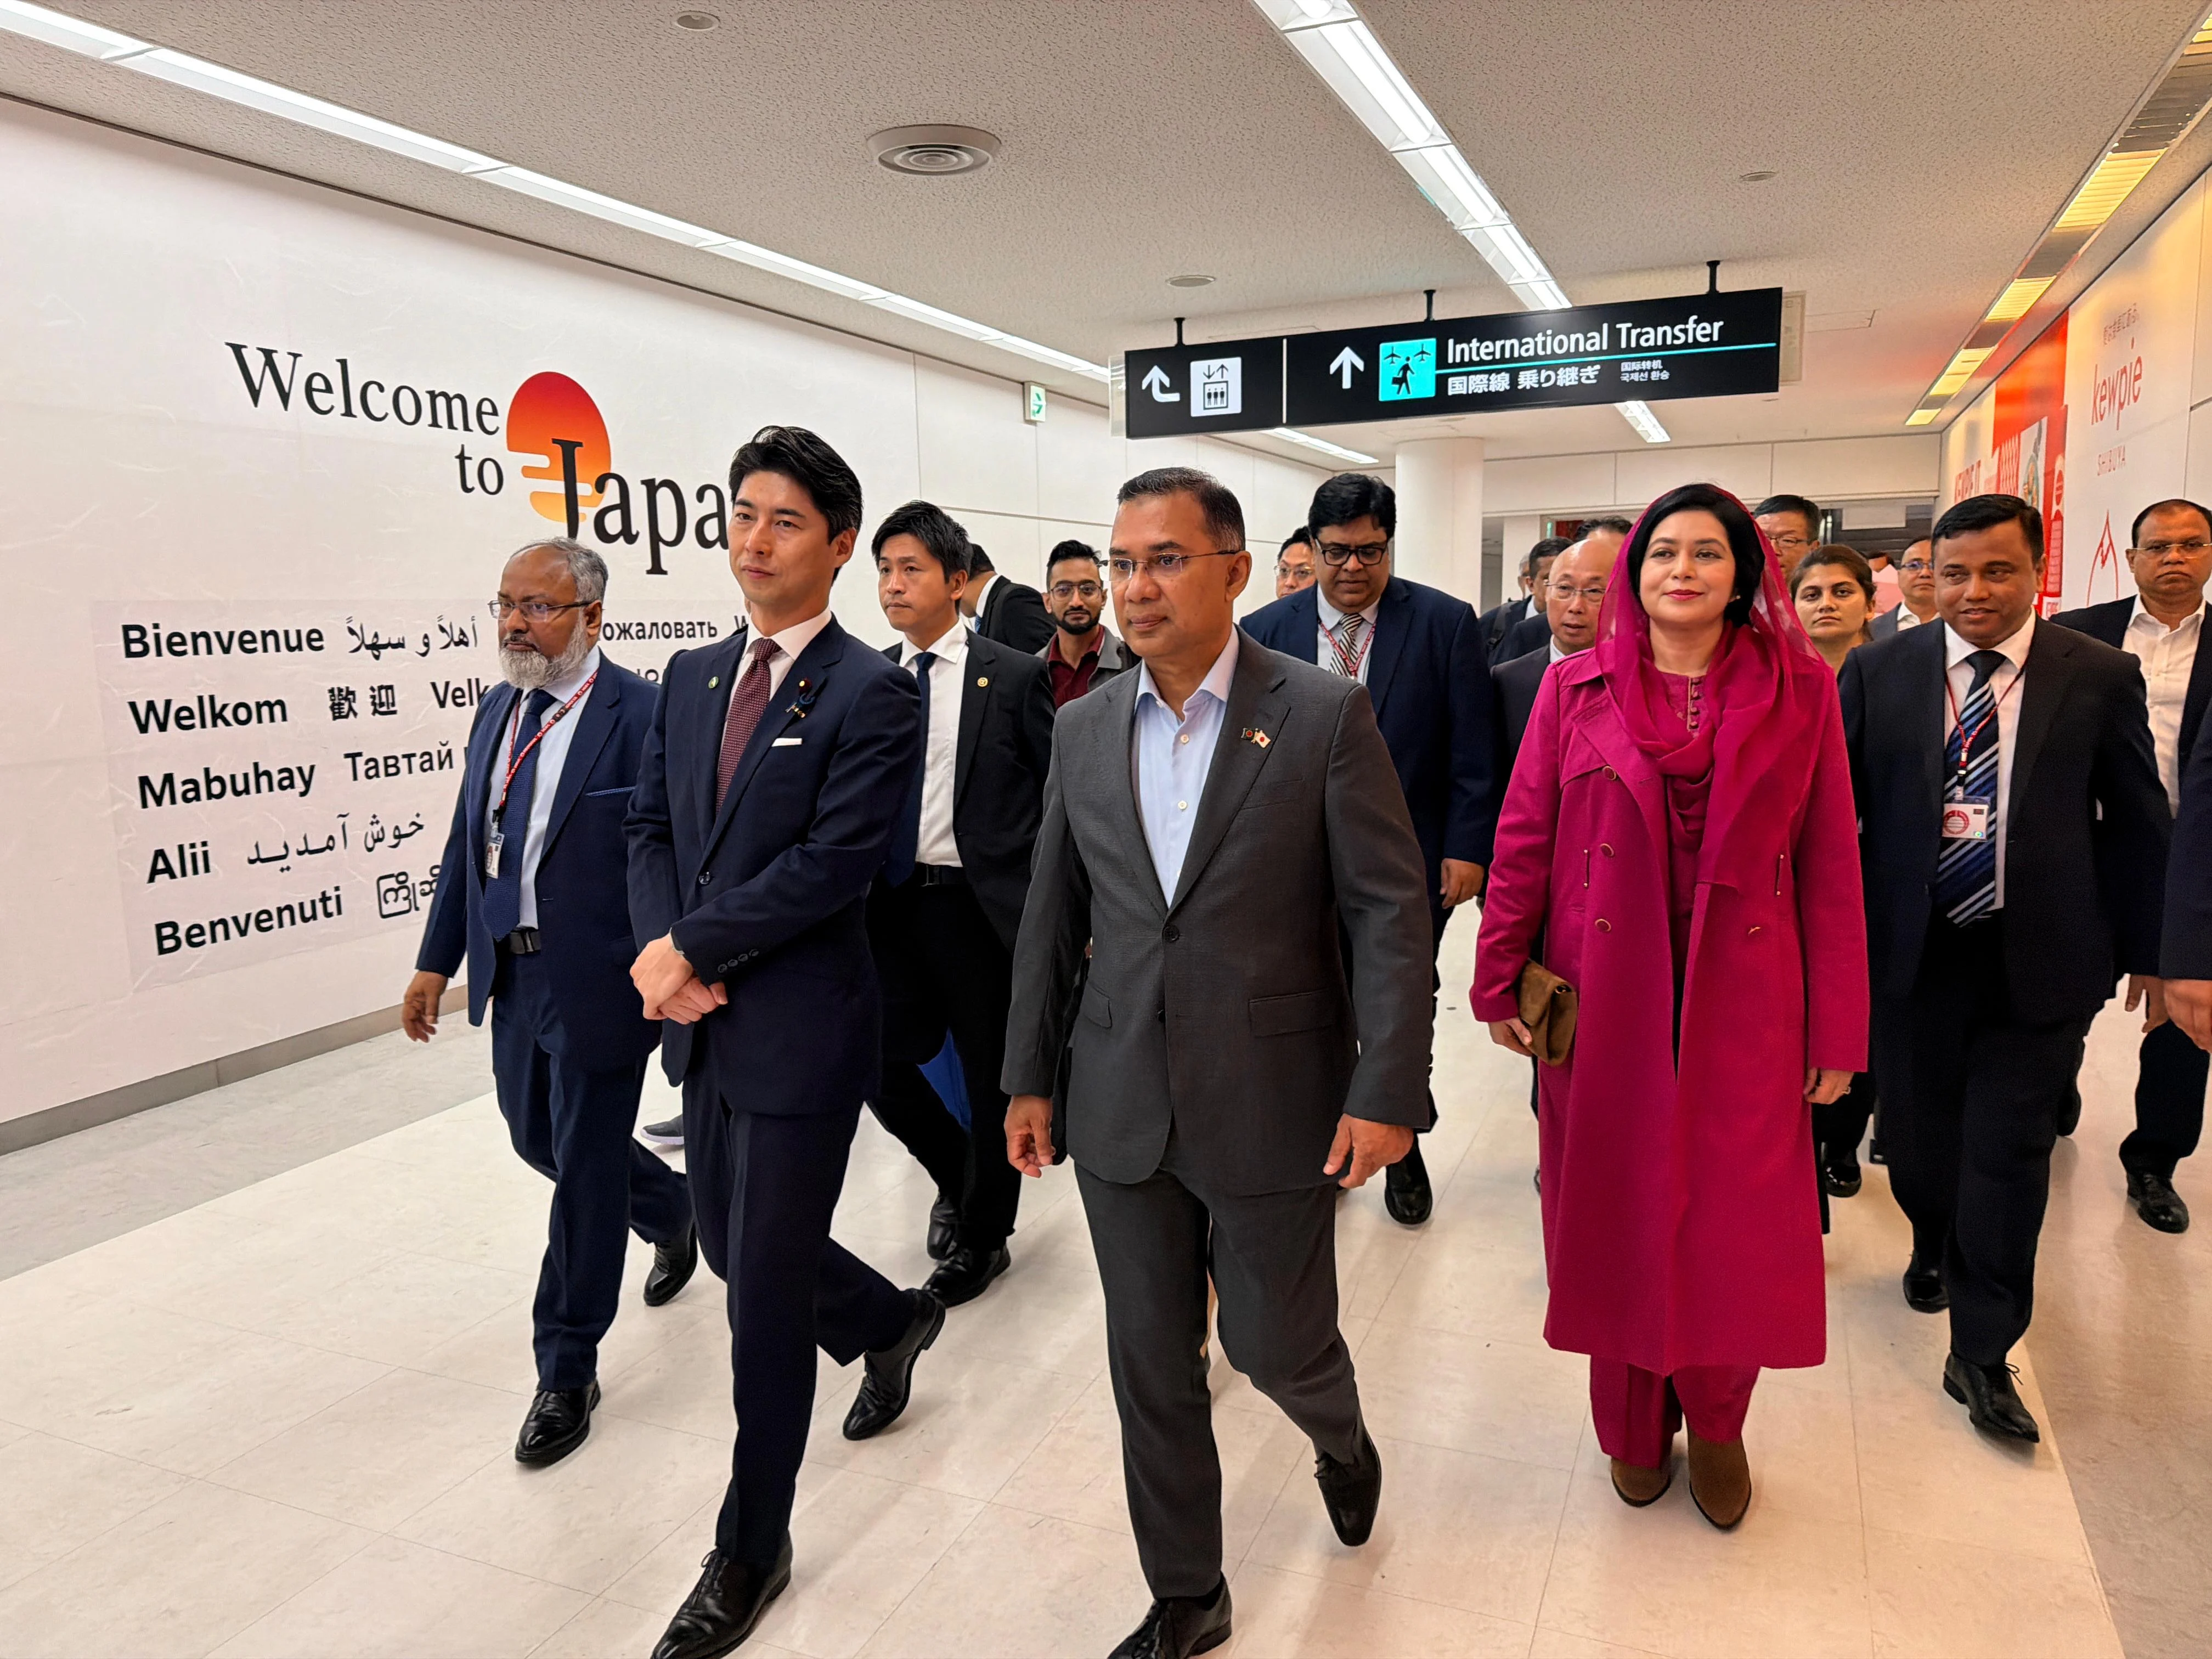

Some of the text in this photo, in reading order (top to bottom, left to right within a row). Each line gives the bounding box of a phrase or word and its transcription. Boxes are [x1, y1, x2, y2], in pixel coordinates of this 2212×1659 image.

[1448, 315, 1724, 364] International Transfer
[225, 342, 500, 436] Welcome
[1448, 364, 1600, 396] 国際線 乗り継ぎ
[2091, 336, 2143, 431] kewpie
[454, 444, 504, 495] to
[551, 438, 730, 575] Japa
[121, 623, 325, 658] Bienvenue
[601, 620, 718, 641] ожаловать
[127, 694, 287, 734] Welkom
[430, 678, 490, 709] Velk
[343, 740, 454, 781] Тавтай
[138, 761, 316, 809] Mabuhay
[146, 840, 211, 884] Alii
[154, 885, 343, 956] Benvenuti
